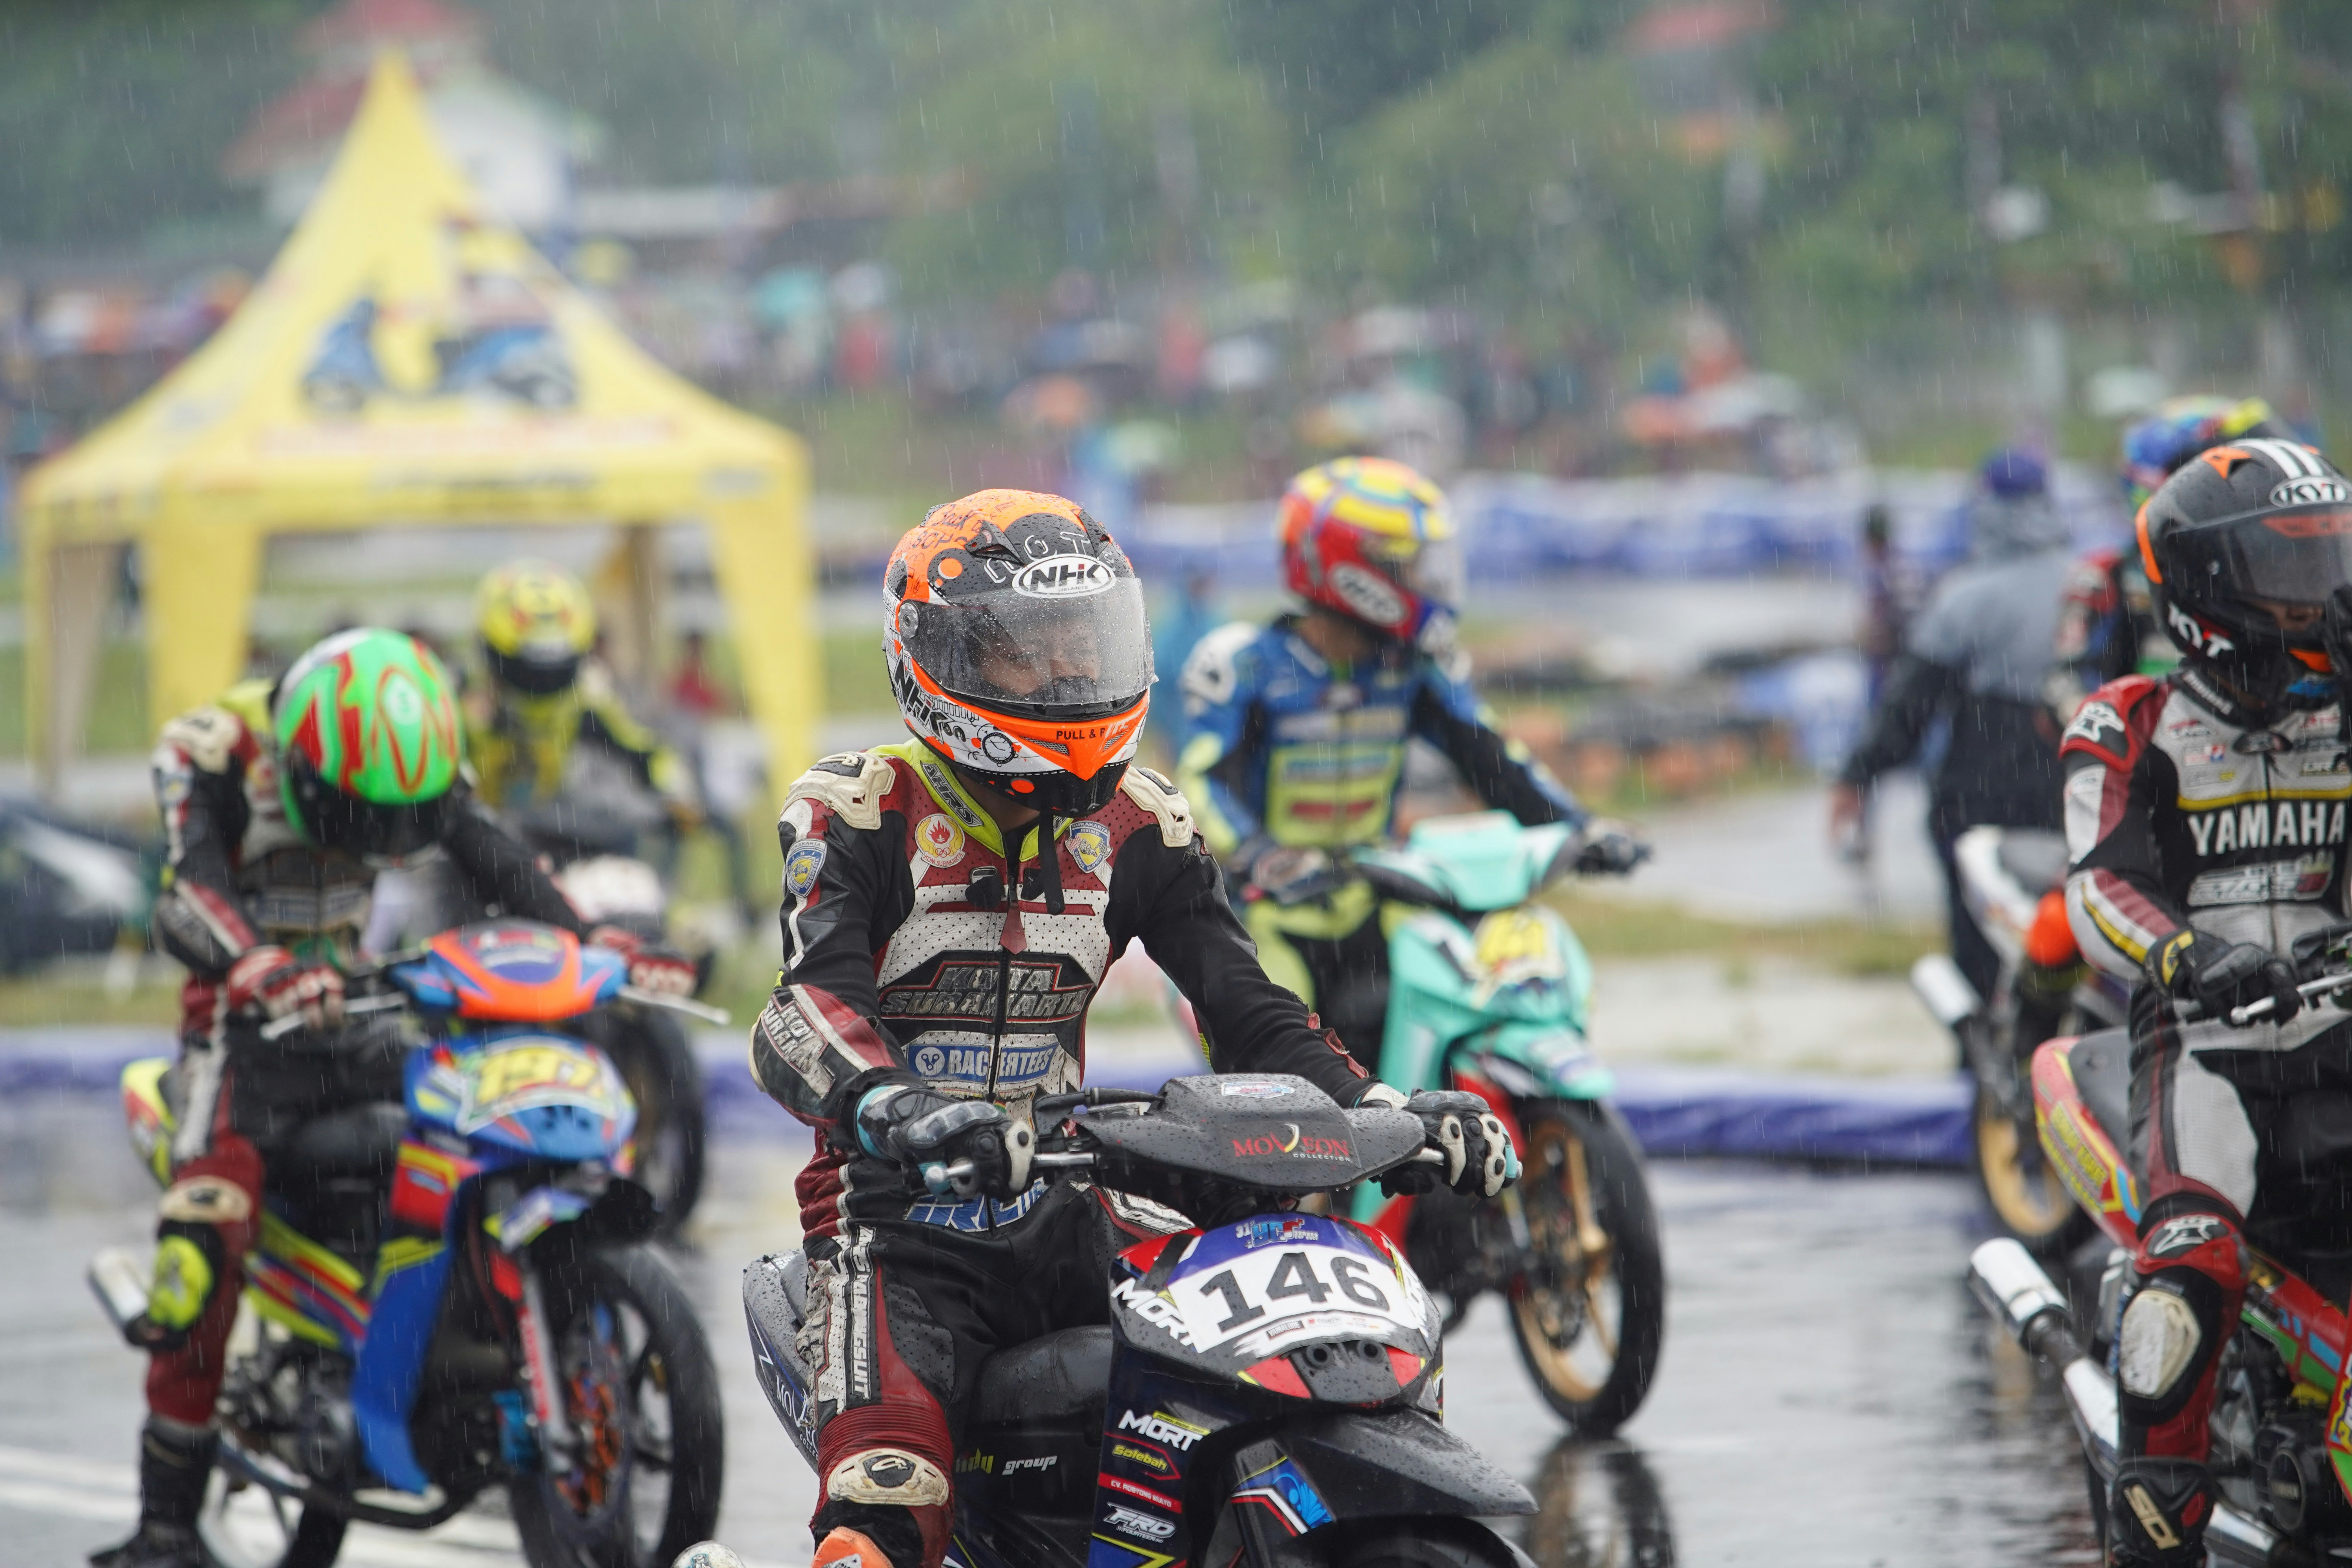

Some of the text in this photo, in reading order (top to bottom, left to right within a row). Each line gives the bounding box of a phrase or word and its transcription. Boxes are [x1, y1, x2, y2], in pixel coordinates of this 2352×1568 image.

[1029, 564, 1102, 592] NHK
[1056, 730, 1085, 740] PULL
[1089, 729, 1096, 739] &
[1071, 822, 1108, 834] SURAKARTA
[2188, 801, 2346, 857] YAMAHA
[923, 853, 963, 866] KONI SURAKARTA
[1293, 1153, 1351, 1162] COLLECTION
[1200, 1252, 1390, 1332] 146
[1269, 1321, 1301, 1337] YAMALUBE
[1118, 1409, 1203, 1451] MORT
[799, 1434, 818, 1461] COLLEC
[1002, 1455, 1058, 1475] group
[1109, 1508, 1175, 1536] FRD
[1122, 1528, 1156, 1541] FOURTEEN
